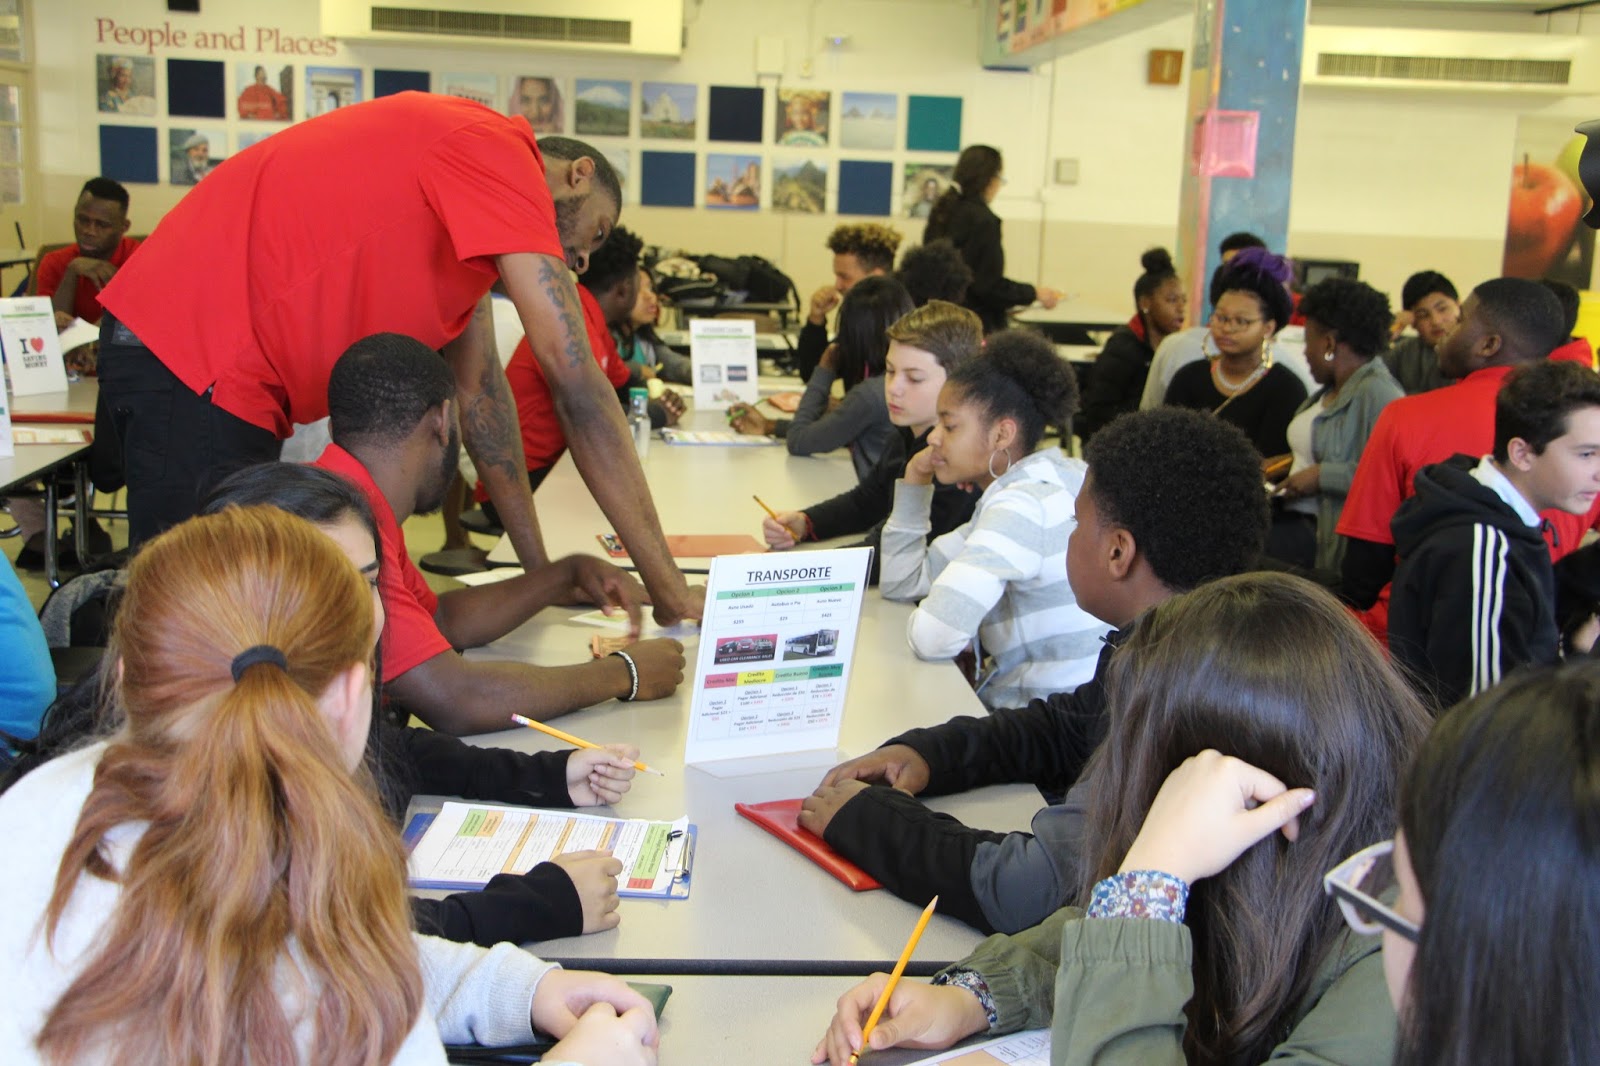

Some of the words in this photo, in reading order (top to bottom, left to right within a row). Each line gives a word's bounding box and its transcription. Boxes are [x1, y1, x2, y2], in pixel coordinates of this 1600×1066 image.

[95, 17, 187, 54] People
[194, 26, 246, 51] and
[255, 26, 338, 57] Places
[747, 566, 832, 583] TRANSPORTE
